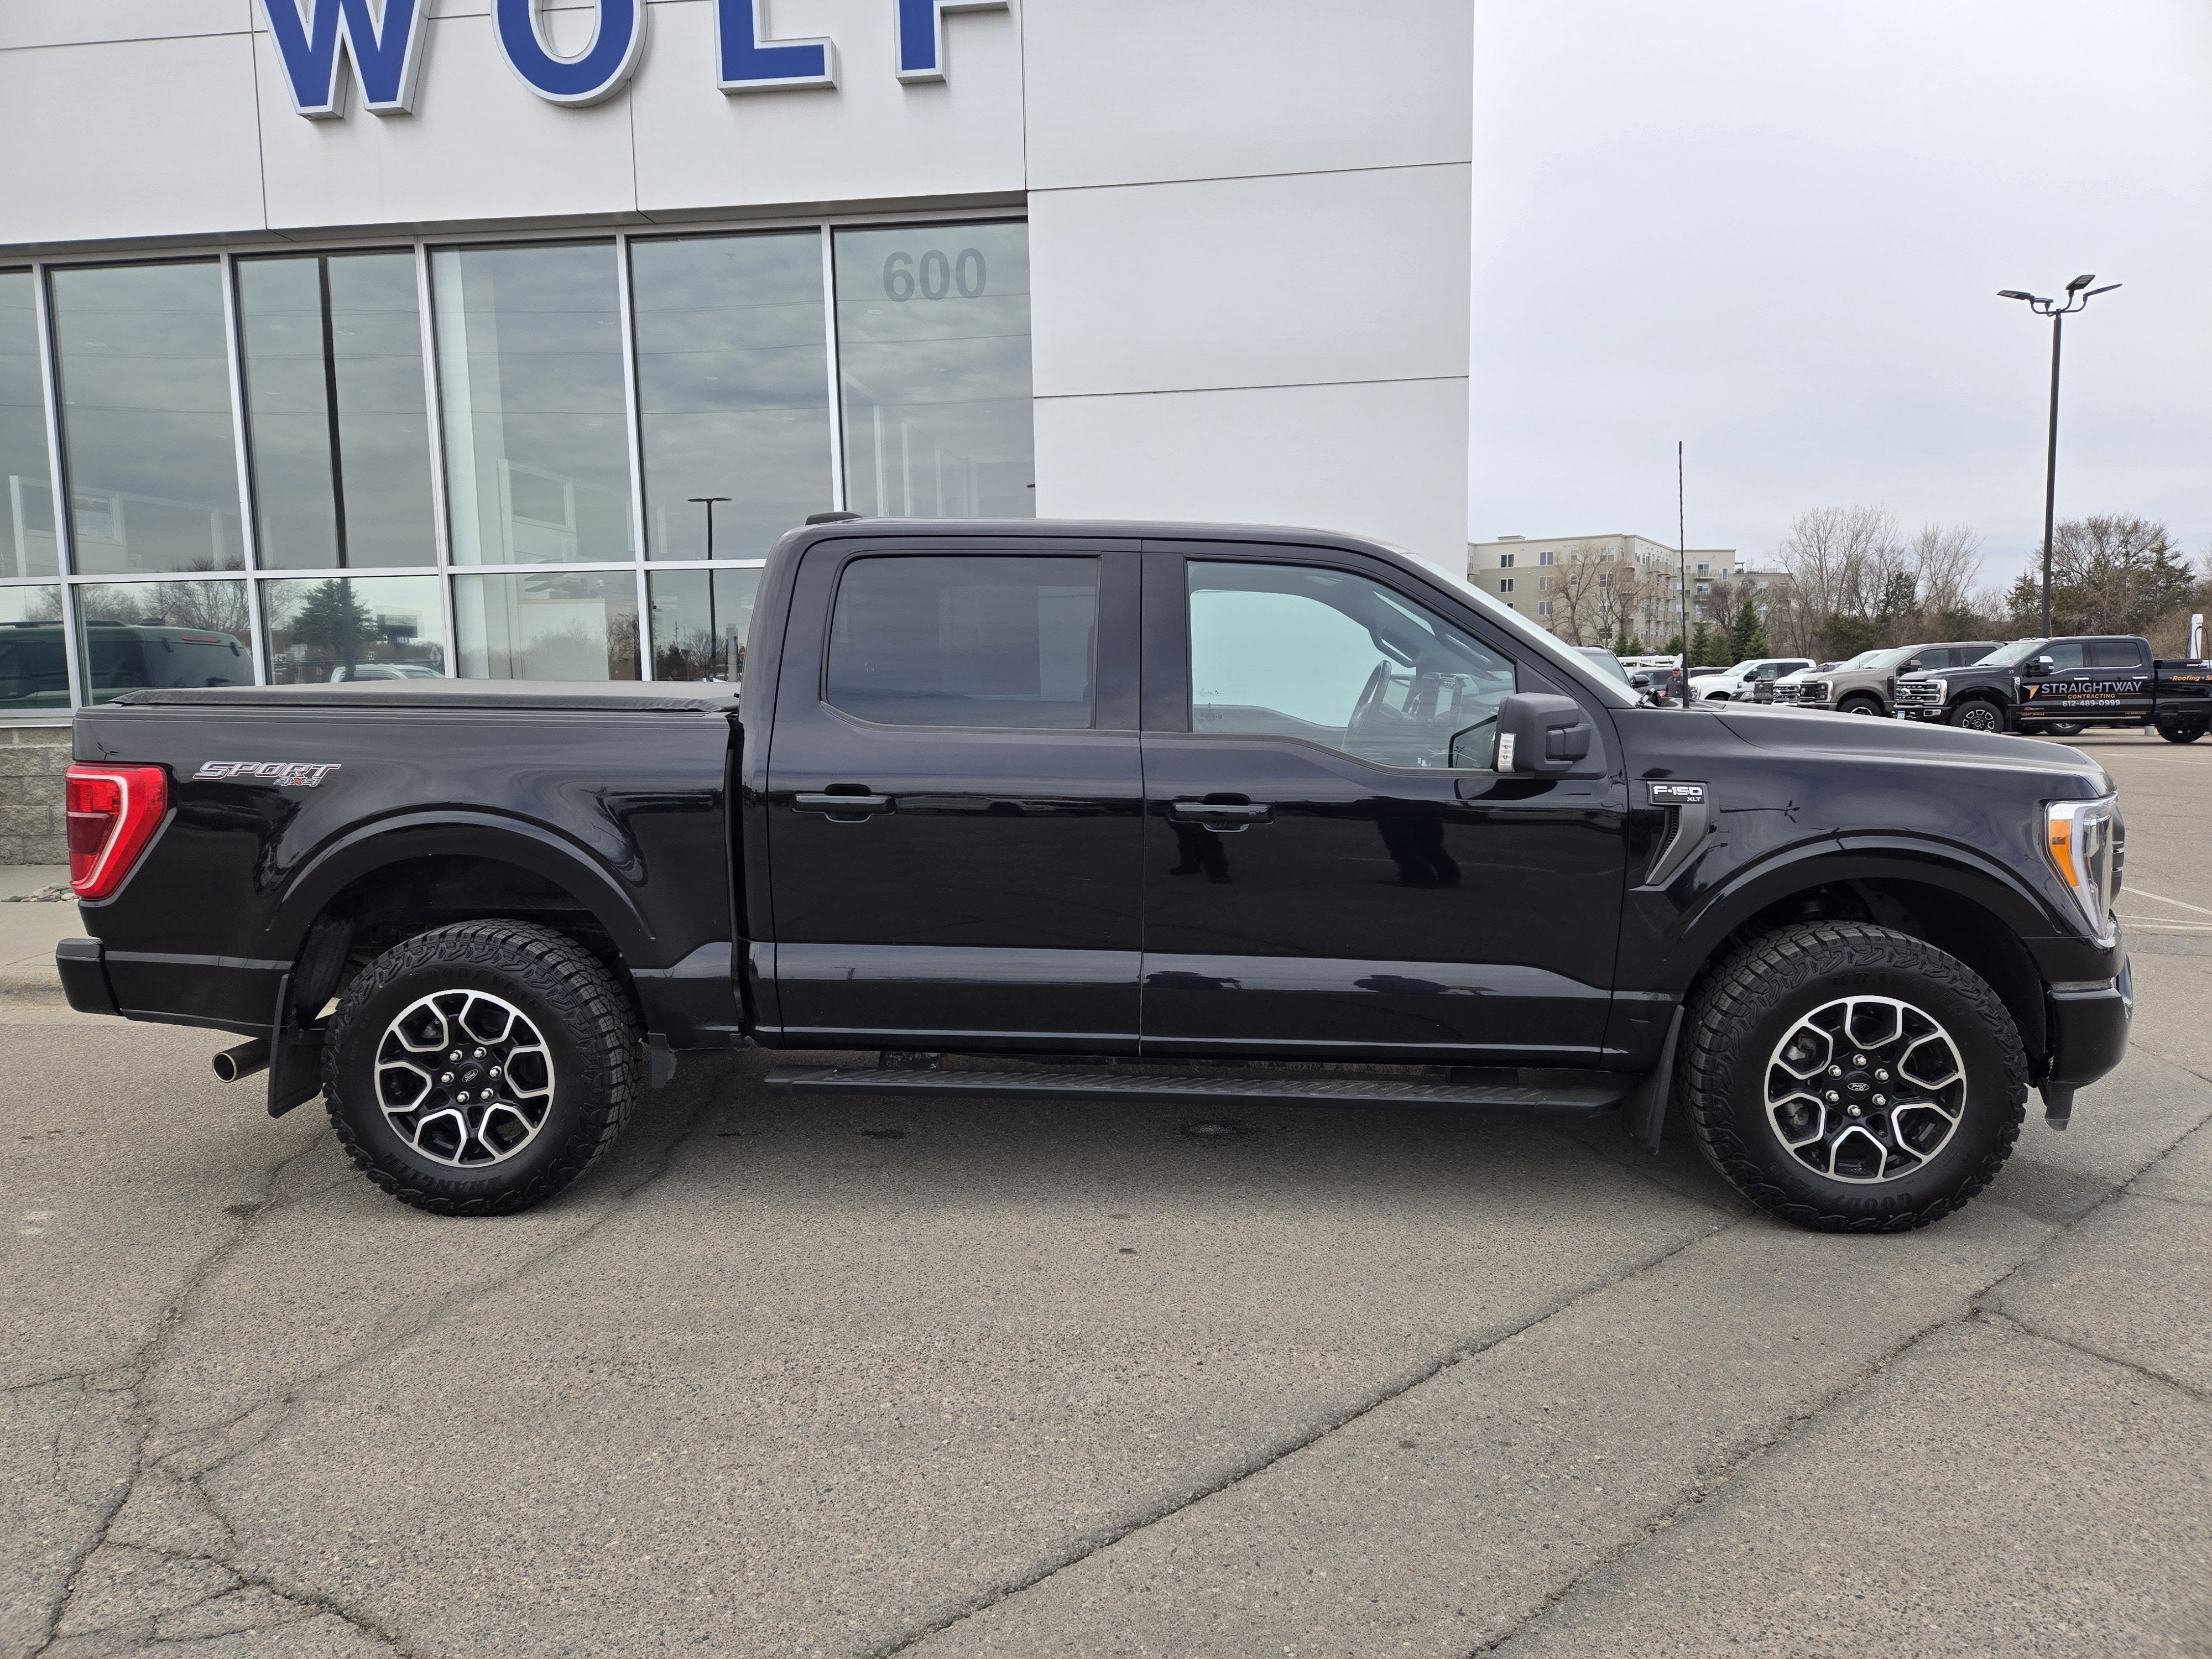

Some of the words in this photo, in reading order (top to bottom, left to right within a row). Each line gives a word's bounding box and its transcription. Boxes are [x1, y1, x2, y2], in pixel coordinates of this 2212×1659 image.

[883, 248, 987, 302] 600
[2041, 681, 2142, 693] STRAIGHTWAY
[192, 761, 342, 780] SPORT
[1653, 785, 1703, 796] F-150
